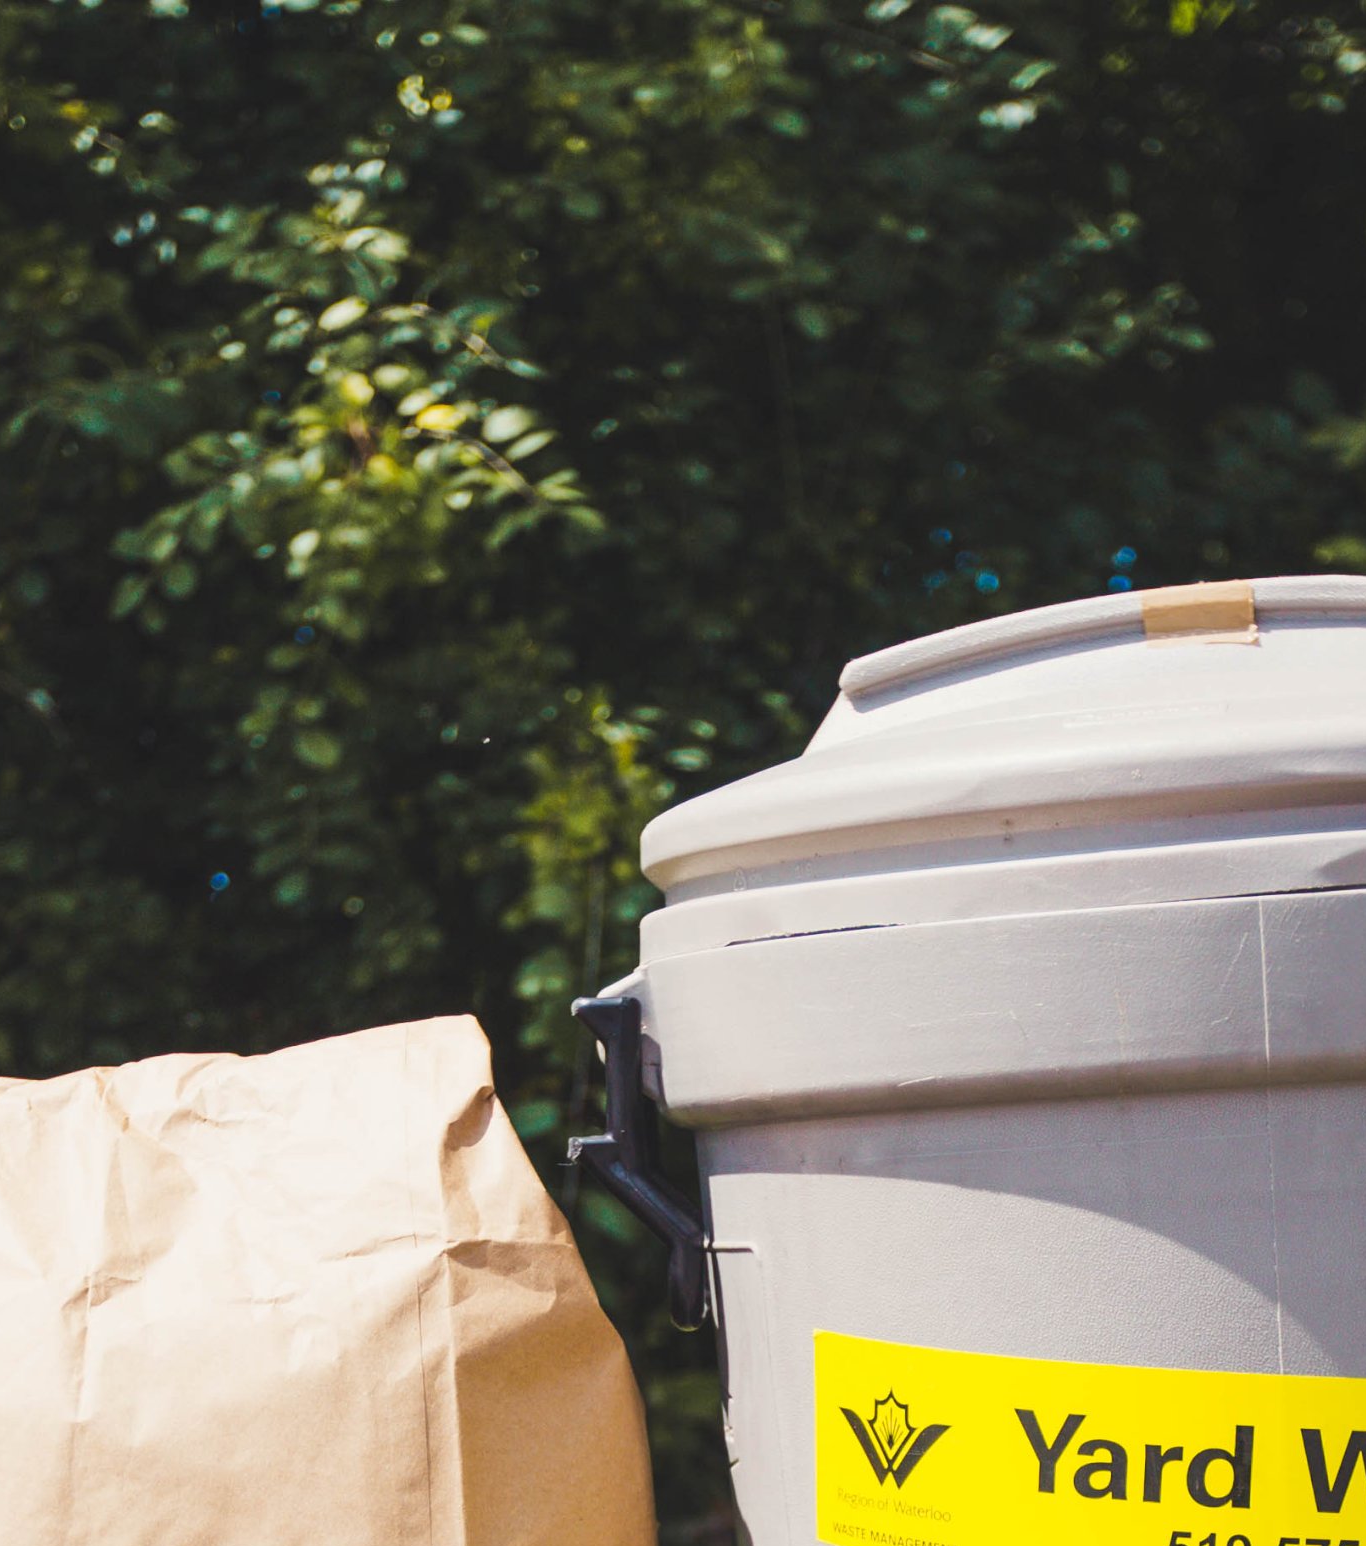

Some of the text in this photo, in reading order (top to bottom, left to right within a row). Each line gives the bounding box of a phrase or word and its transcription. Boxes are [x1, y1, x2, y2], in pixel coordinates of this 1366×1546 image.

[1014, 1408, 1255, 1509] Yard
[836, 1487, 952, 1522] Region of Waterloo
[832, 1520, 866, 1540] WASTE
